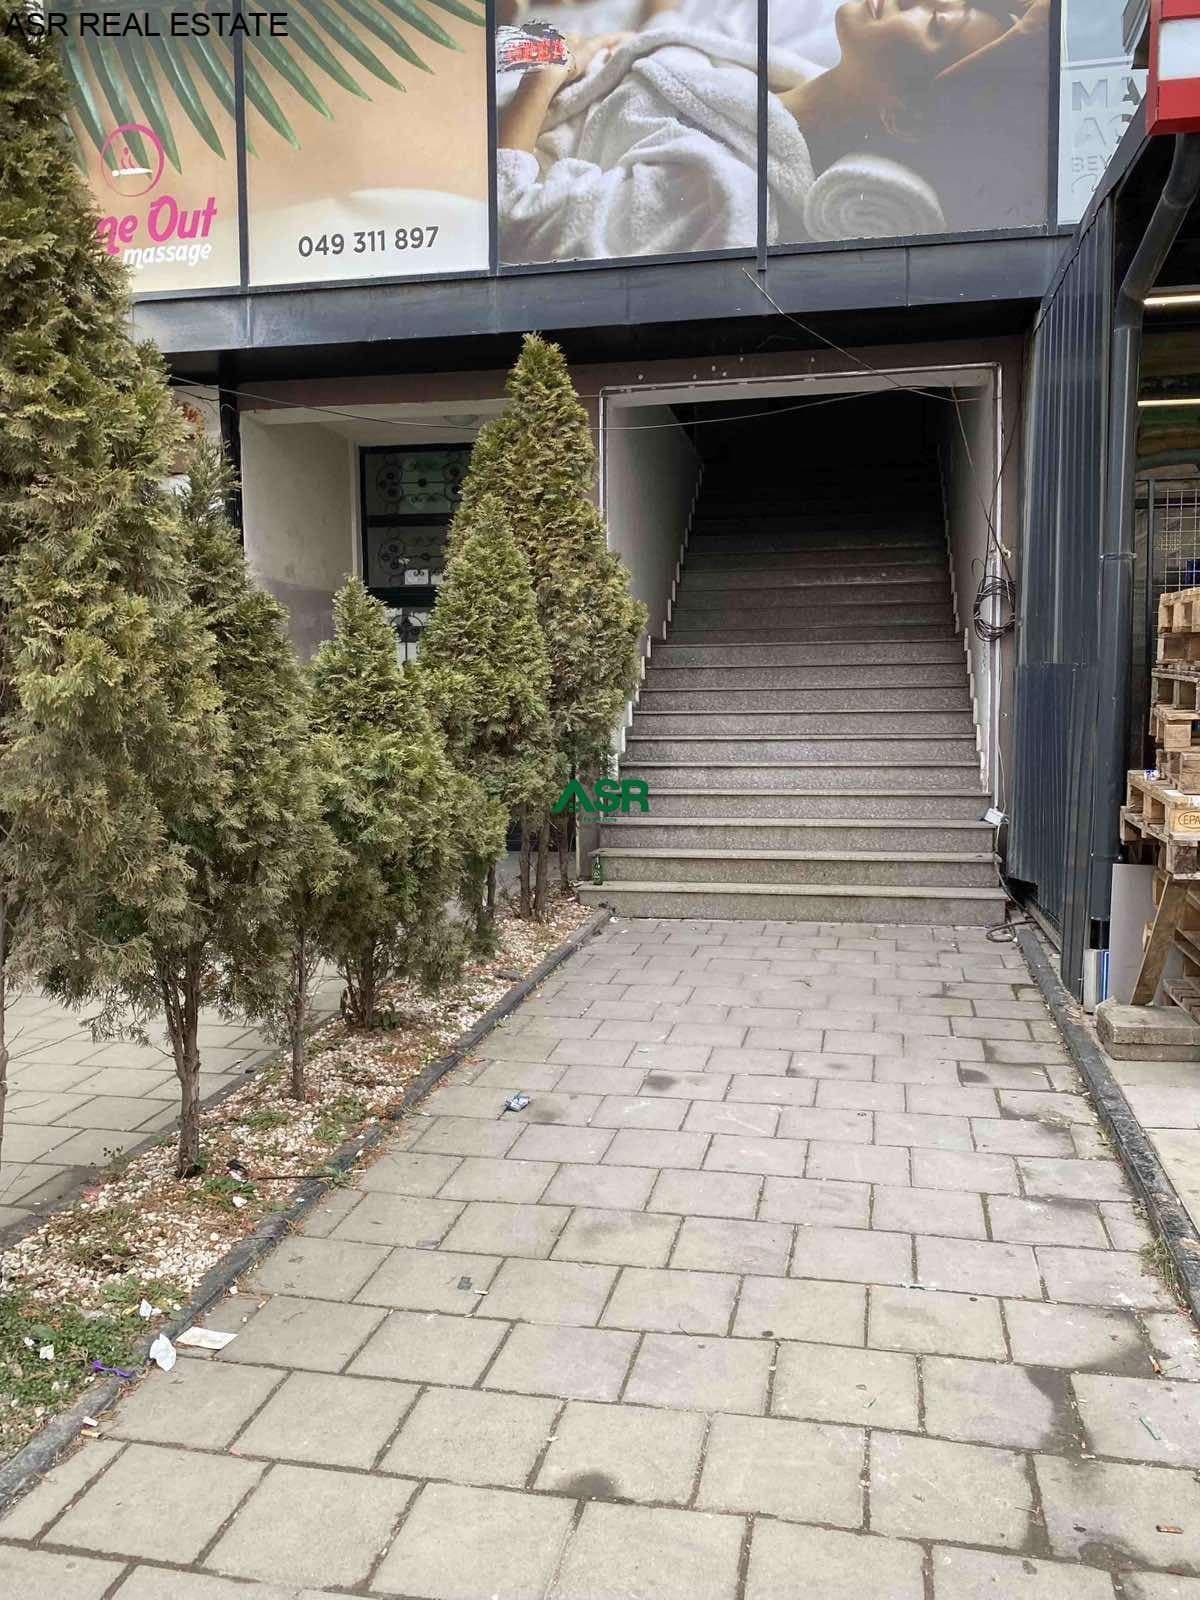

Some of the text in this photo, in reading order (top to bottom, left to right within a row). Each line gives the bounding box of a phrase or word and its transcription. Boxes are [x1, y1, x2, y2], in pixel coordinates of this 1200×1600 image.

[148, 195, 217, 242] Out
[123, 242, 213, 269] massage
[298, 225, 440, 258] 049 311 897
